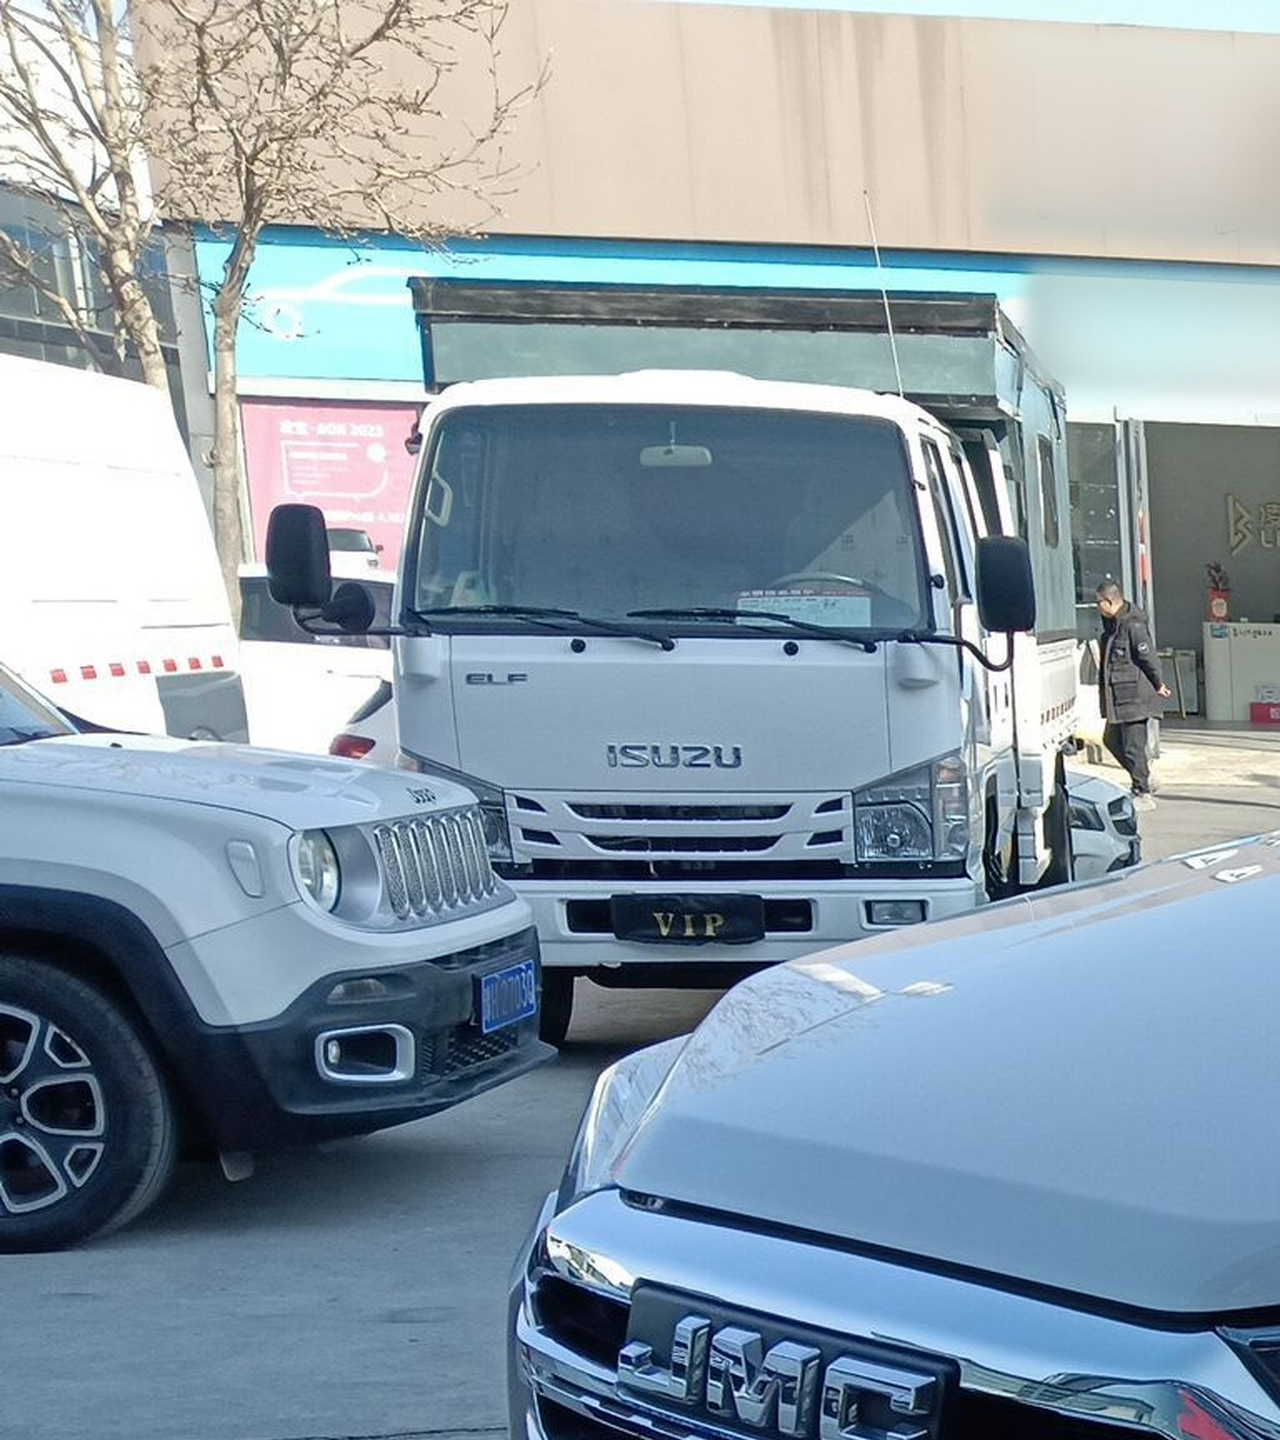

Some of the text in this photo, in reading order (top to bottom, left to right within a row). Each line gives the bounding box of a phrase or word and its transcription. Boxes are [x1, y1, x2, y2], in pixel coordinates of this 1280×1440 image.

[465, 672, 528, 686] ELF
[606, 744, 742, 768] ISUZU
[652, 911, 725, 937] VIP
